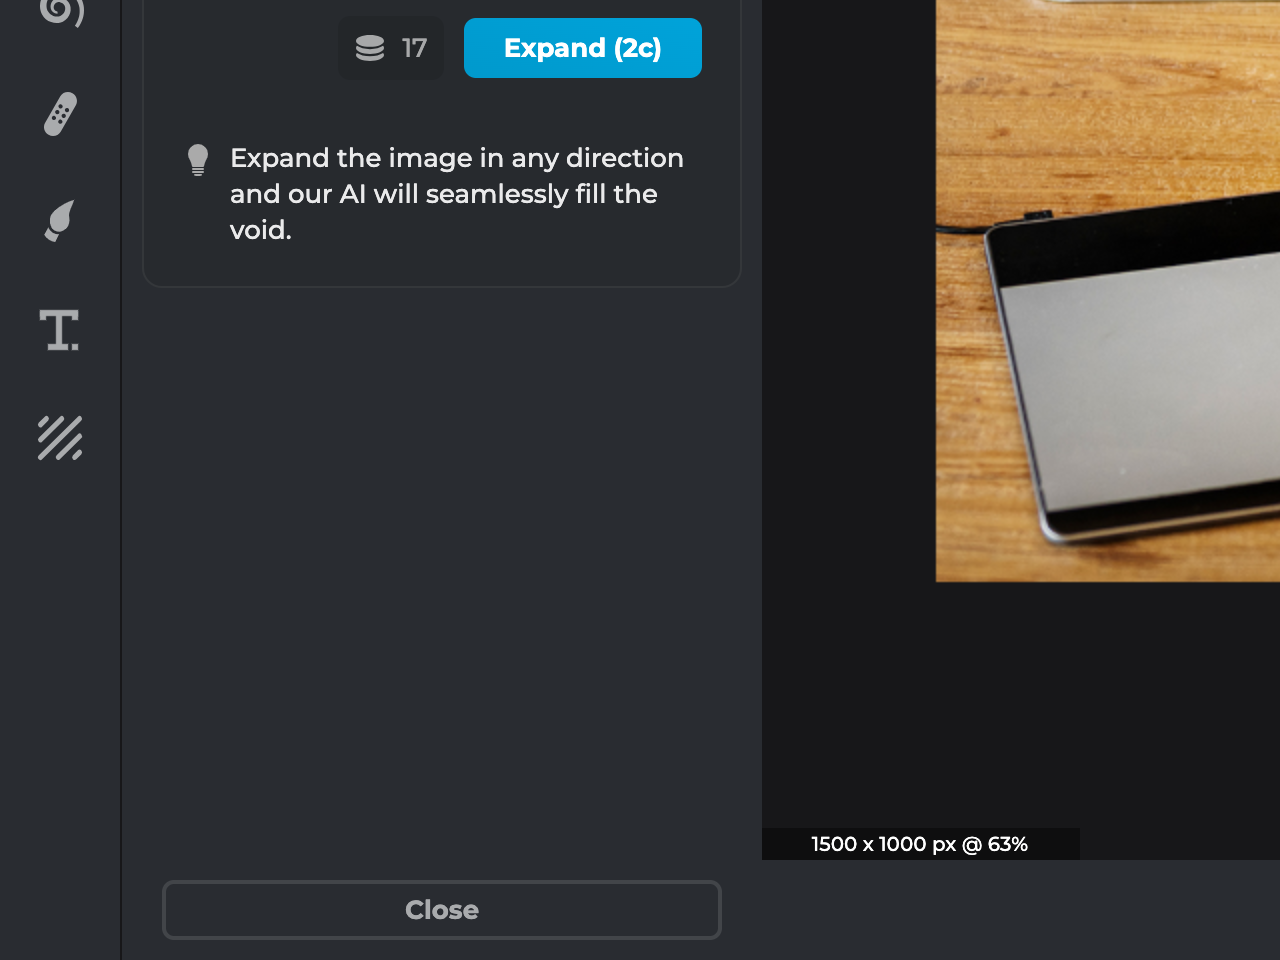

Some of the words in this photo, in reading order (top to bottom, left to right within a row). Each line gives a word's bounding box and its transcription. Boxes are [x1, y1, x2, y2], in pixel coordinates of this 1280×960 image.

[402, 38, 427, 57] 17
[505, 37, 605, 62] Expand
[615, 37, 661, 62] (2c)
[232, 147, 328, 172] Expand
[337, 147, 381, 167] the
[390, 147, 472, 173] image
[481, 147, 503, 167] in
[512, 152, 559, 173] any
[567, 147, 683, 168] direction
[231, 183, 279, 203] and
[289, 188, 332, 204] our
[339, 184, 365, 203] AI
[374, 183, 417, 203] will
[426, 183, 569, 208] seamlessly
[575, 183, 605, 203] fill
[613, 183, 657, 204] the
[230, 219, 291, 240] void.
[811, 836, 857, 852] 1500
[863, 840, 874, 851] x
[879, 836, 926, 852] 1000
[933, 840, 956, 855] px
[962, 836, 982, 855] @
[988, 836, 1028, 852] 63%
[406, 899, 479, 920] Close
